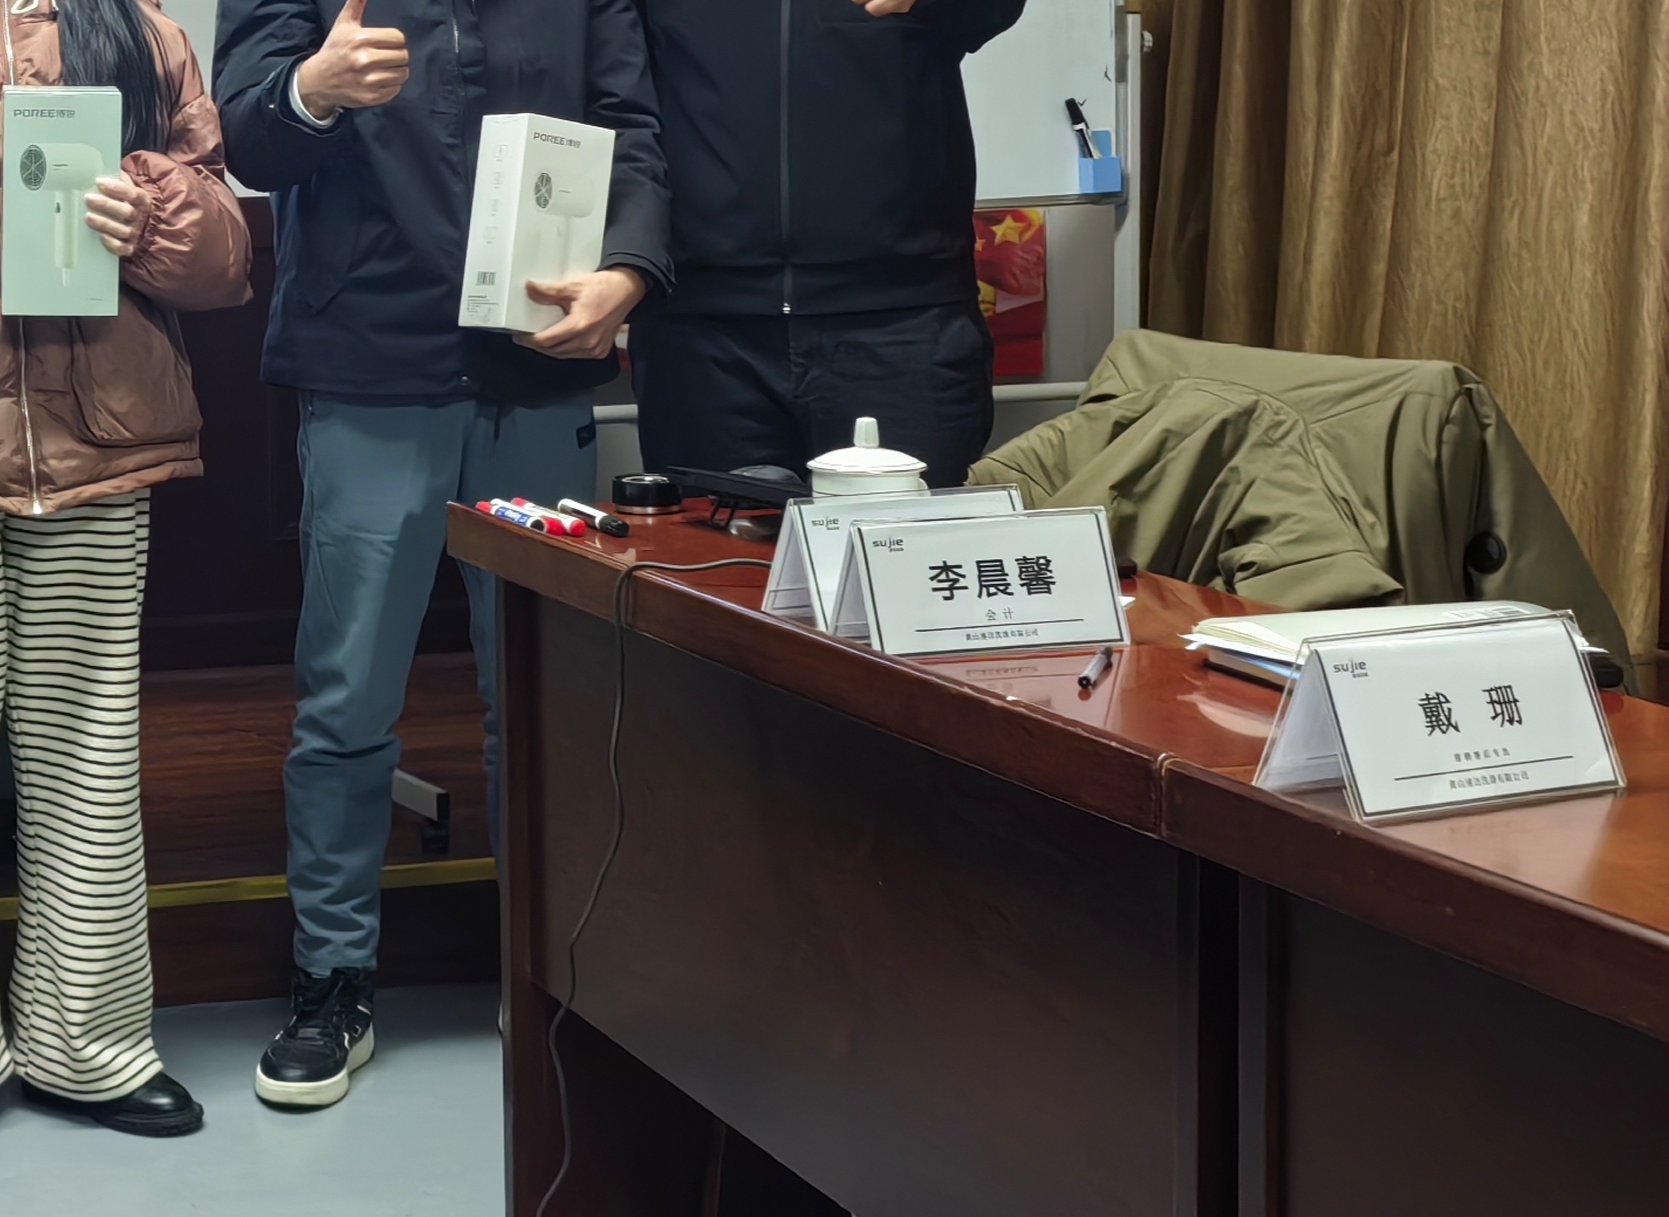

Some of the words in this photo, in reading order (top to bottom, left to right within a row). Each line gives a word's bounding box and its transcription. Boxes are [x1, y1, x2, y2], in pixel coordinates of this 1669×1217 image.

[928, 555, 1057, 601] 李晨馨
[985, 607, 1014, 621] 会计
